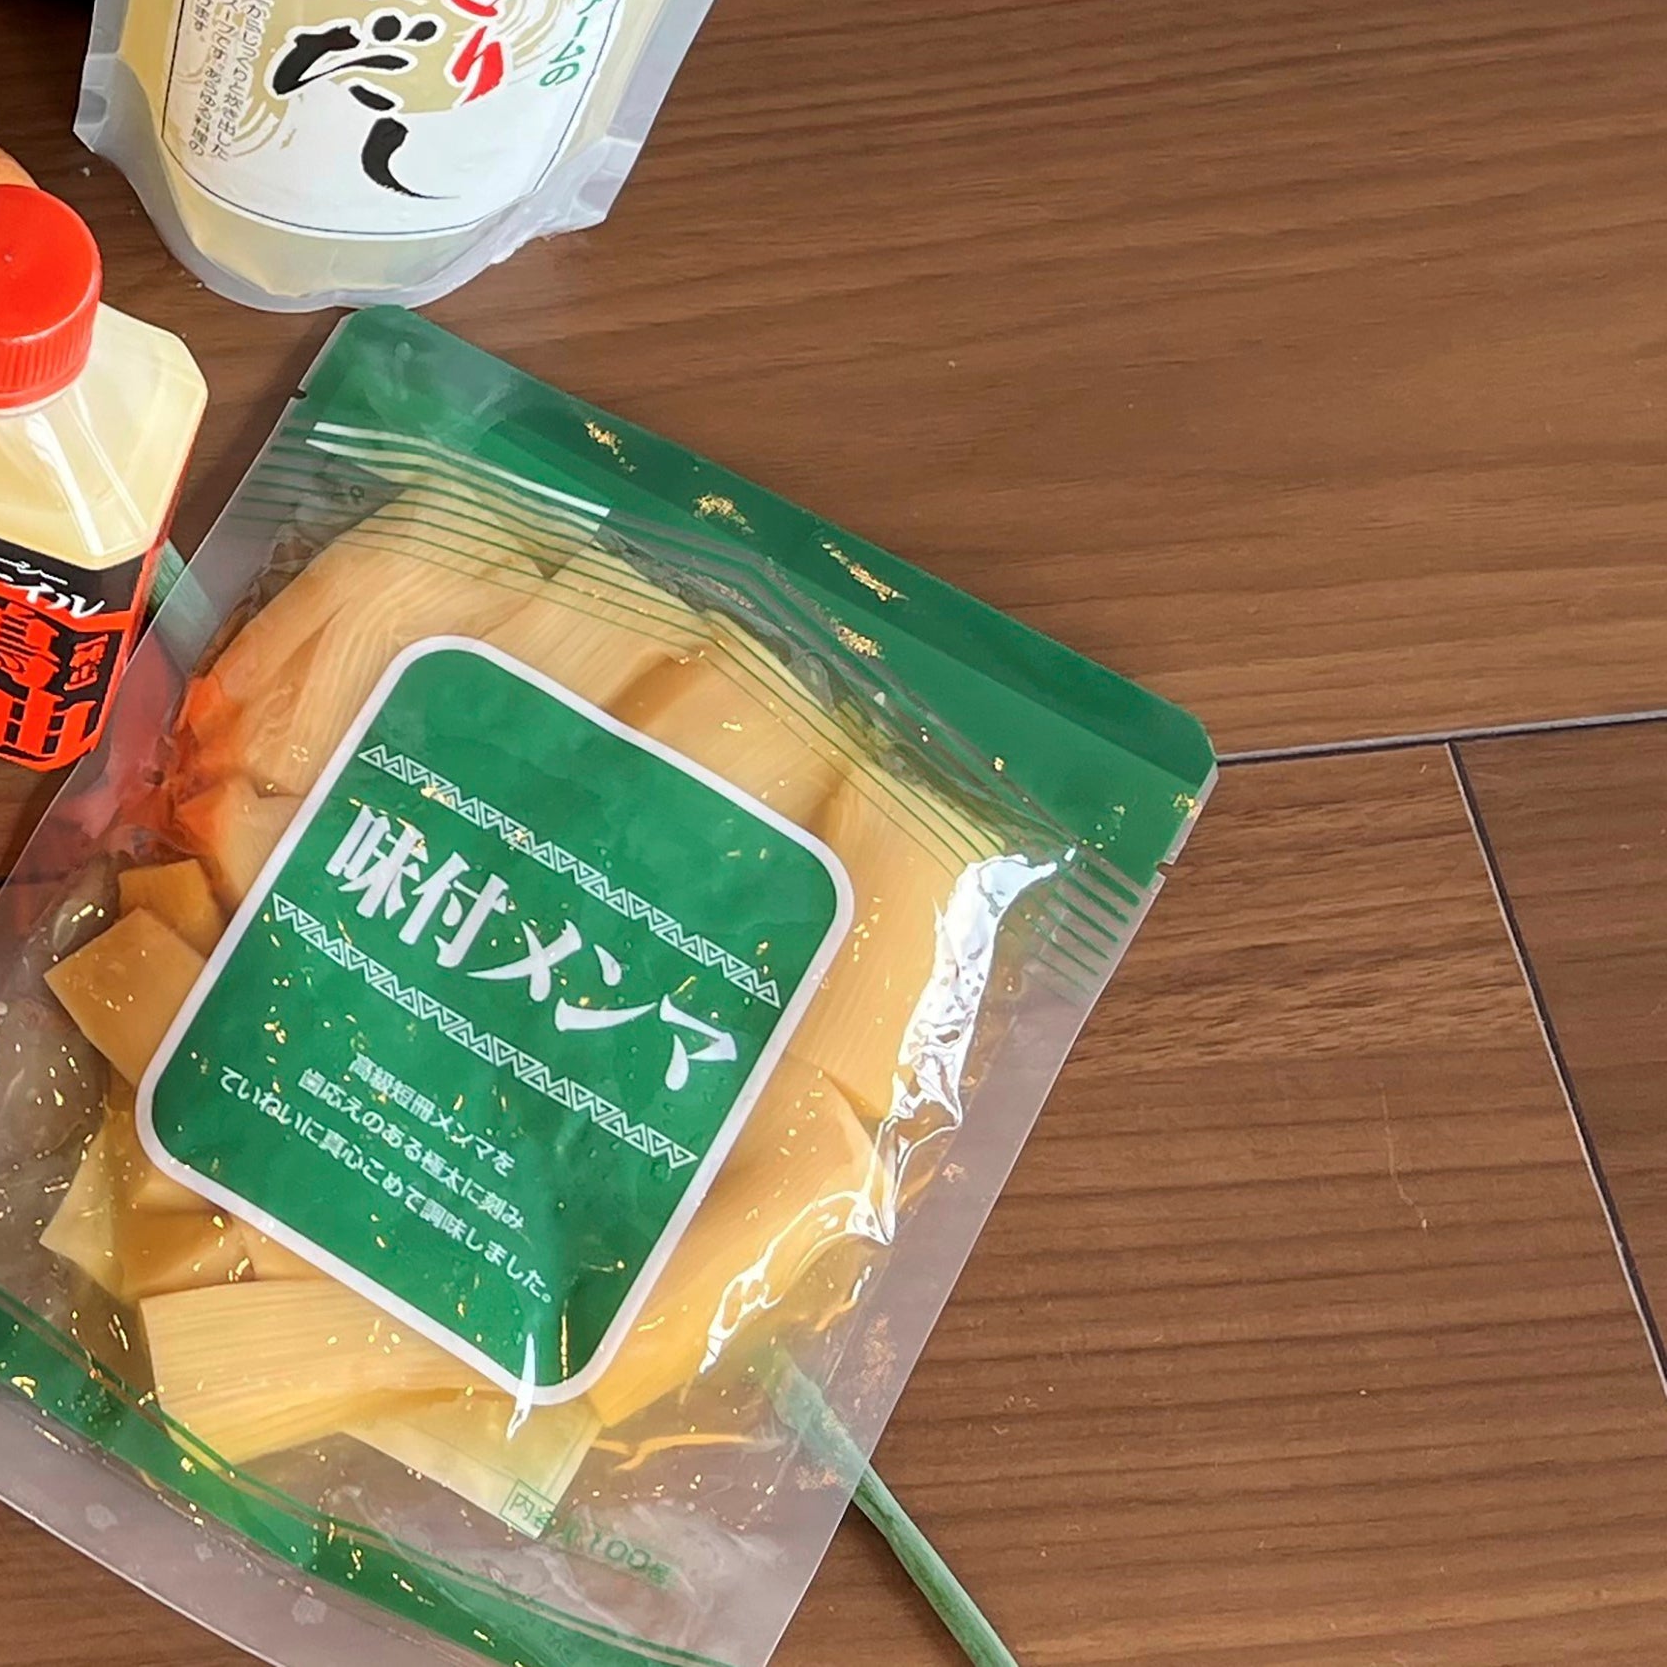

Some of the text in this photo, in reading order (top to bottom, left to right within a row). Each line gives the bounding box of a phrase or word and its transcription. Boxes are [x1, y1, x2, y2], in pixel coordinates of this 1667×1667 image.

[324, 802, 738, 1092] 味付メンマ
[219, 1065, 553, 1304] ていねいに真心こめて調味しました。
[297, 1067, 525, 1232] 歯応えのある極太に刻み
[348, 1051, 517, 1178] 高級短冊メンマを
